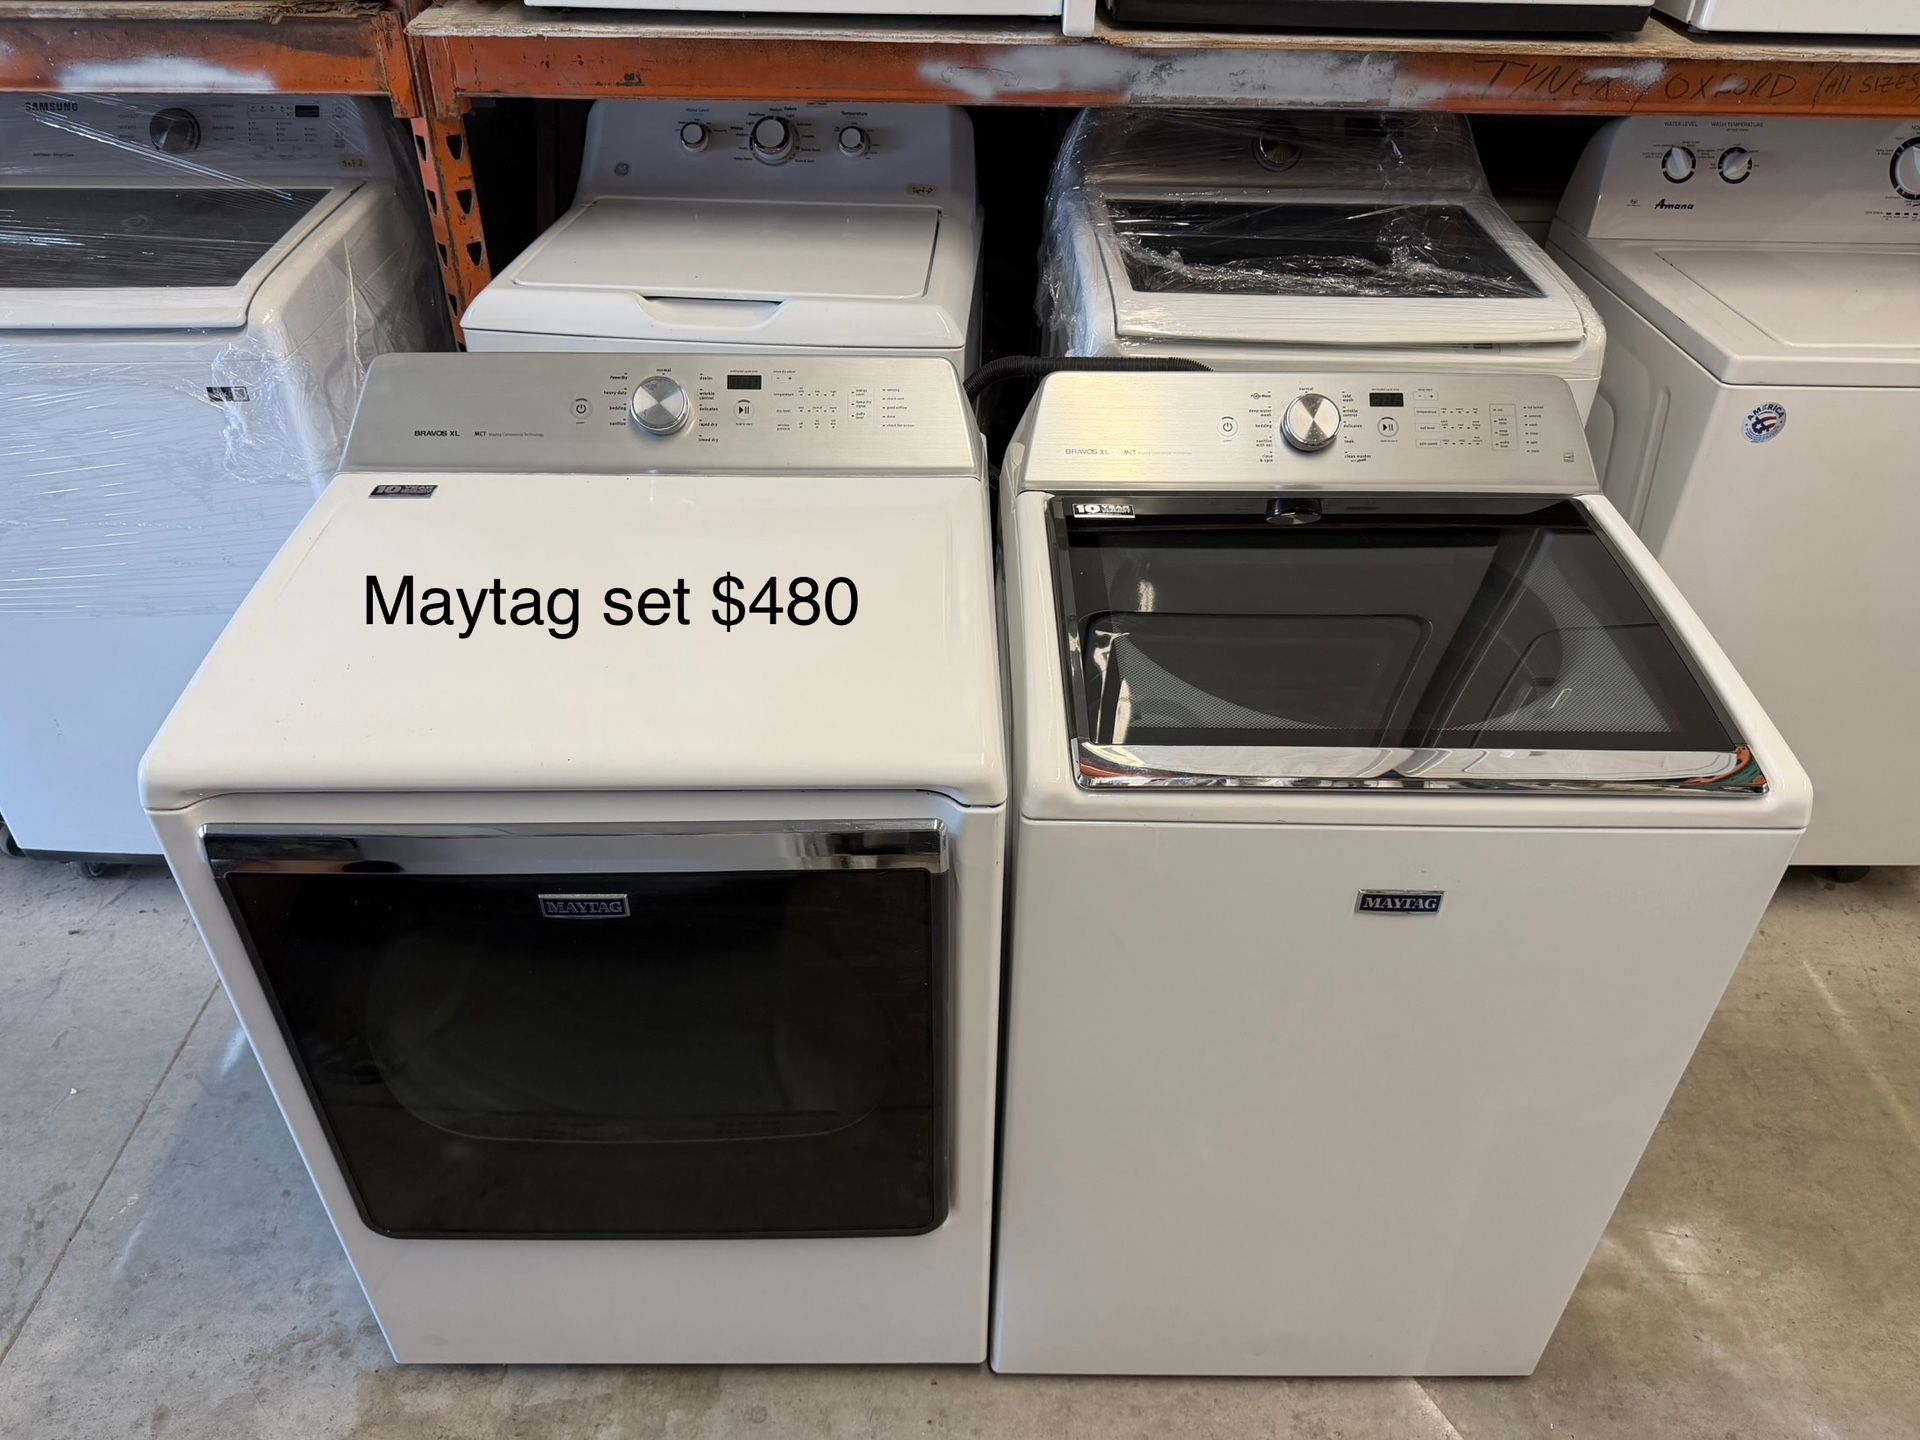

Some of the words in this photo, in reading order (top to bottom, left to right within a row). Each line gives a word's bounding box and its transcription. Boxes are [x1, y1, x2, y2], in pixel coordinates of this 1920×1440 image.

[25, 102, 78, 111] SAMSUNG
[1654, 199, 1694, 210] Amana
[376, 485, 402, 494] 10
[1076, 505, 1100, 513] 10
[546, 901, 623, 913] MAYTAG
[1362, 897, 1437, 909] MAYTAG
